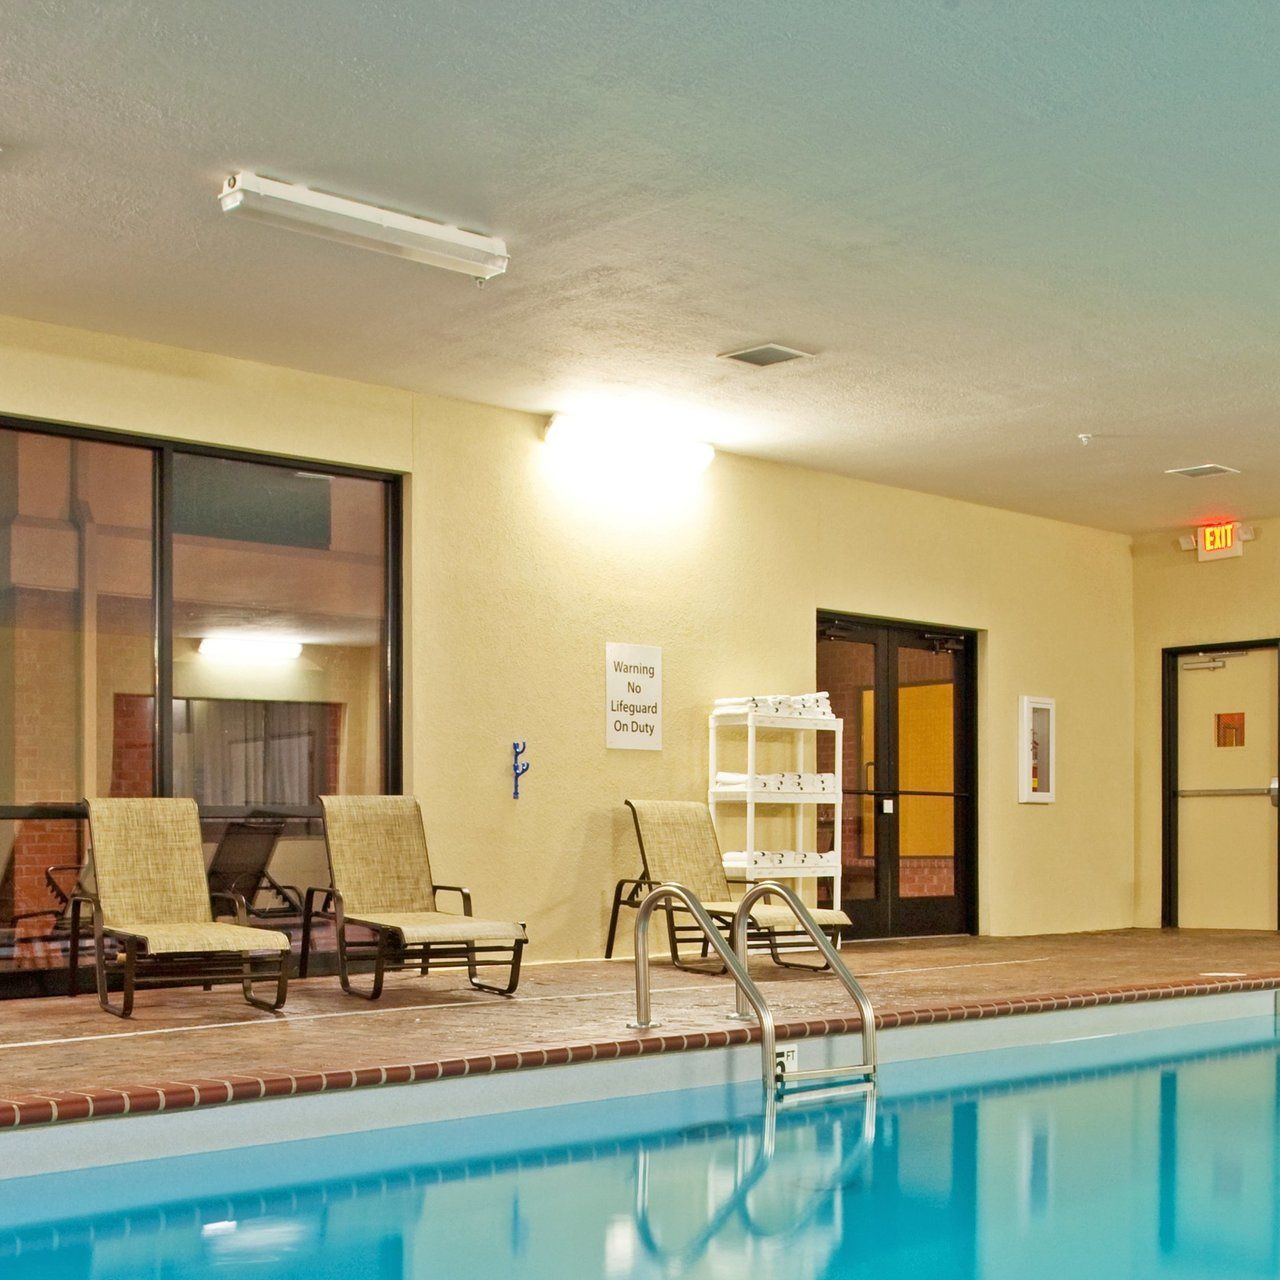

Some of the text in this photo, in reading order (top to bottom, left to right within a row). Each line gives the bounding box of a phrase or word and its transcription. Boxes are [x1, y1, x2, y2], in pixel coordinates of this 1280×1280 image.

[1204, 524, 1233, 551] EXIT
[613, 660, 655, 679] Warning
[627, 681, 642, 694] No
[610, 699, 658, 716] Lifeguard
[613, 719, 655, 736] On Duty
[786, 1049, 796, 1061] FT
